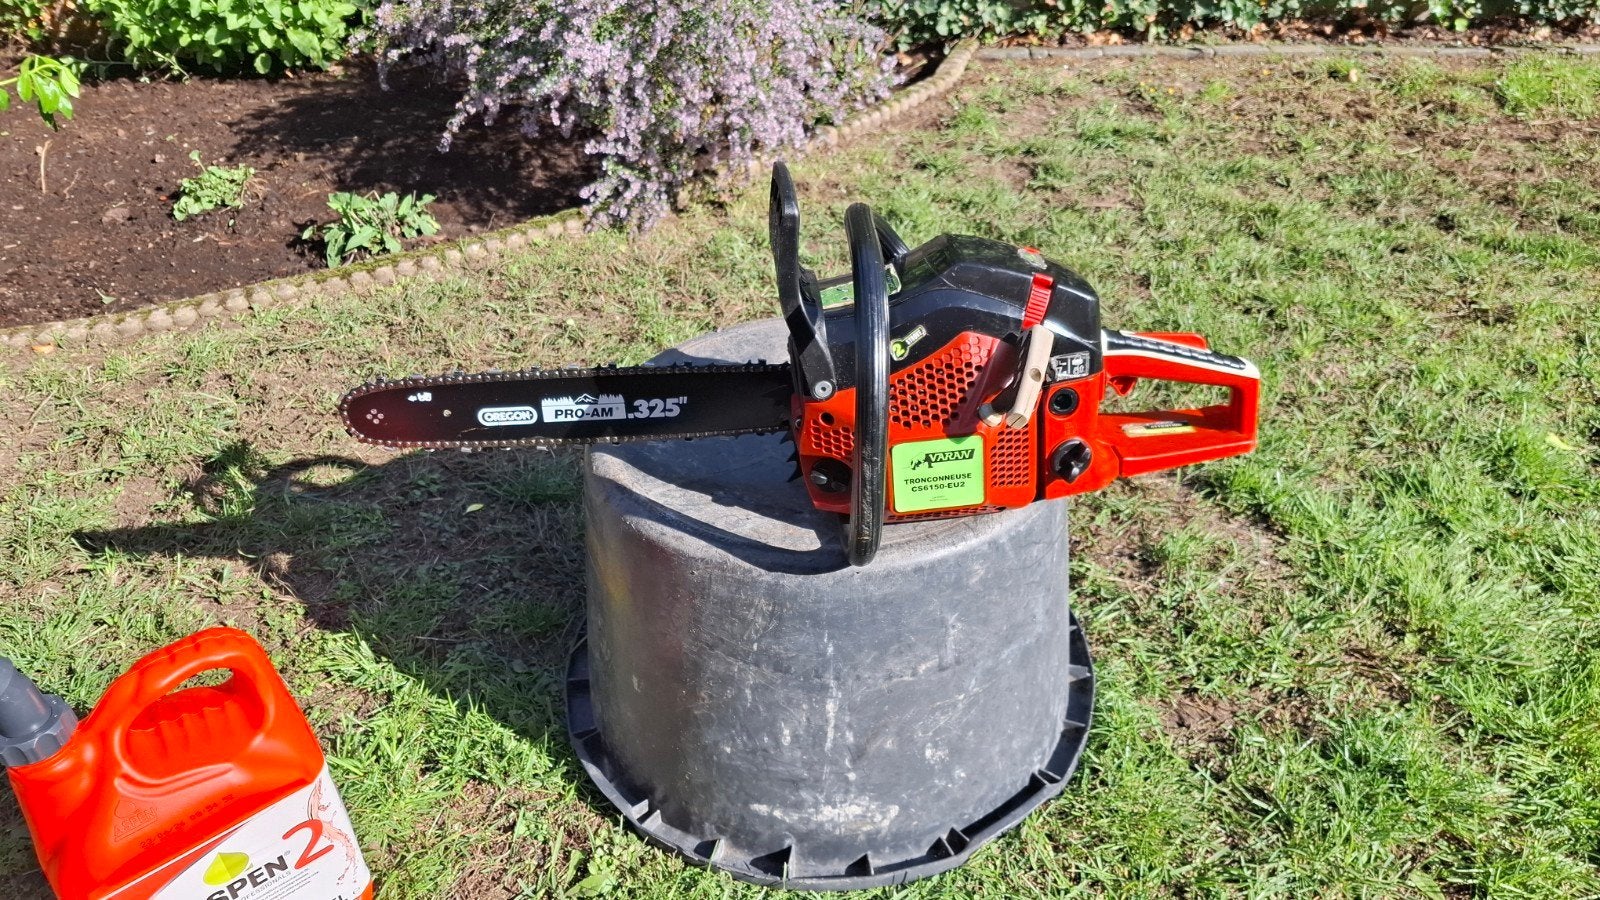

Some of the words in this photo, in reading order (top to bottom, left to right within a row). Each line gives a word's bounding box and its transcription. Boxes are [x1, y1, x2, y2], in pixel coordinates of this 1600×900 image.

[892, 343, 906, 357] 2
[484, 411, 530, 422] OREGON
[554, 407, 613, 419] PRO-AM
[928, 449, 973, 463] VARAN
[904, 472, 972, 485] TRONCONNEUSE
[911, 481, 966, 493] CS6150-EU2
[281, 818, 335, 870] 2
